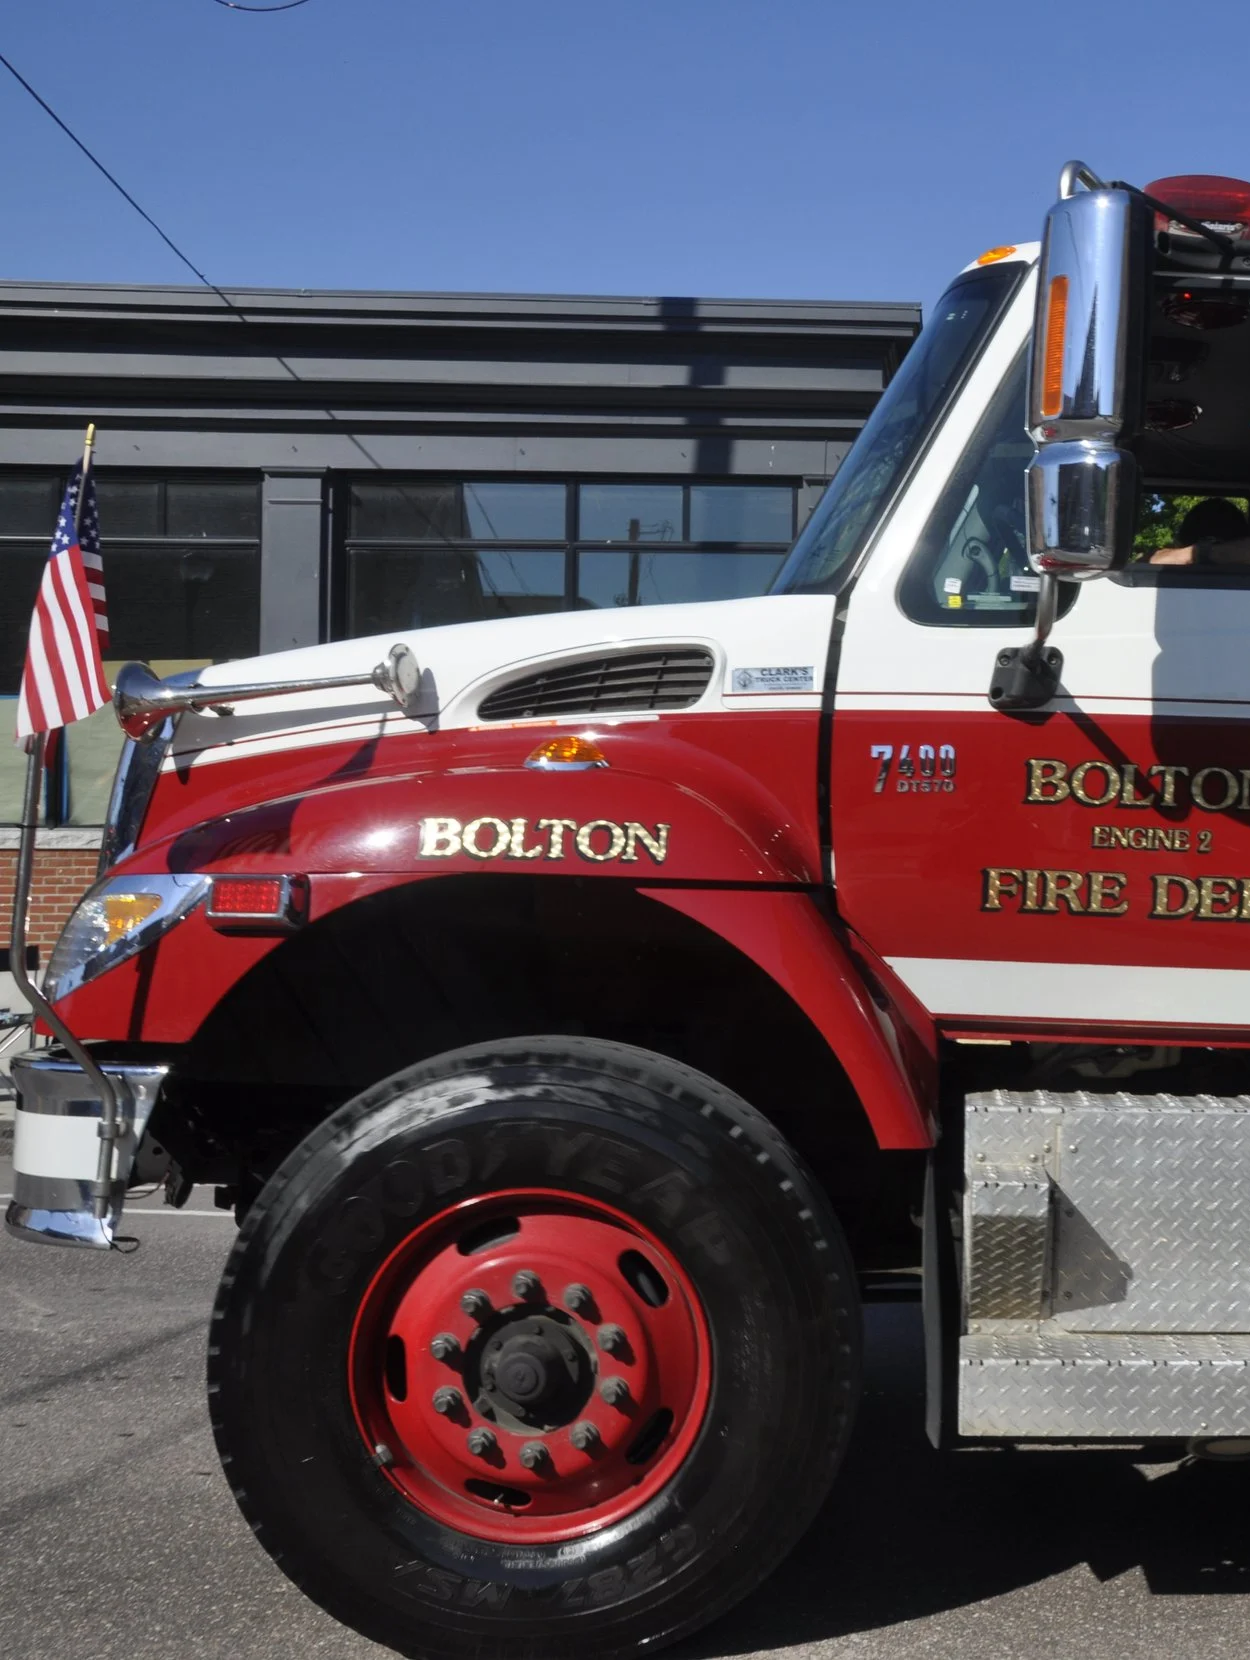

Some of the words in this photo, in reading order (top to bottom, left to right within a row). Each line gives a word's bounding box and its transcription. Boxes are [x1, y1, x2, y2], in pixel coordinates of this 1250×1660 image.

[760, 667, 809, 677] CLARK'S
[870, 744, 956, 793] 7400
[418, 817, 671, 863] BOLTON
[1092, 825, 1191, 851] ENGINE
[1197, 829, 1213, 853] 2
[981, 867, 1129, 914] FIRE
